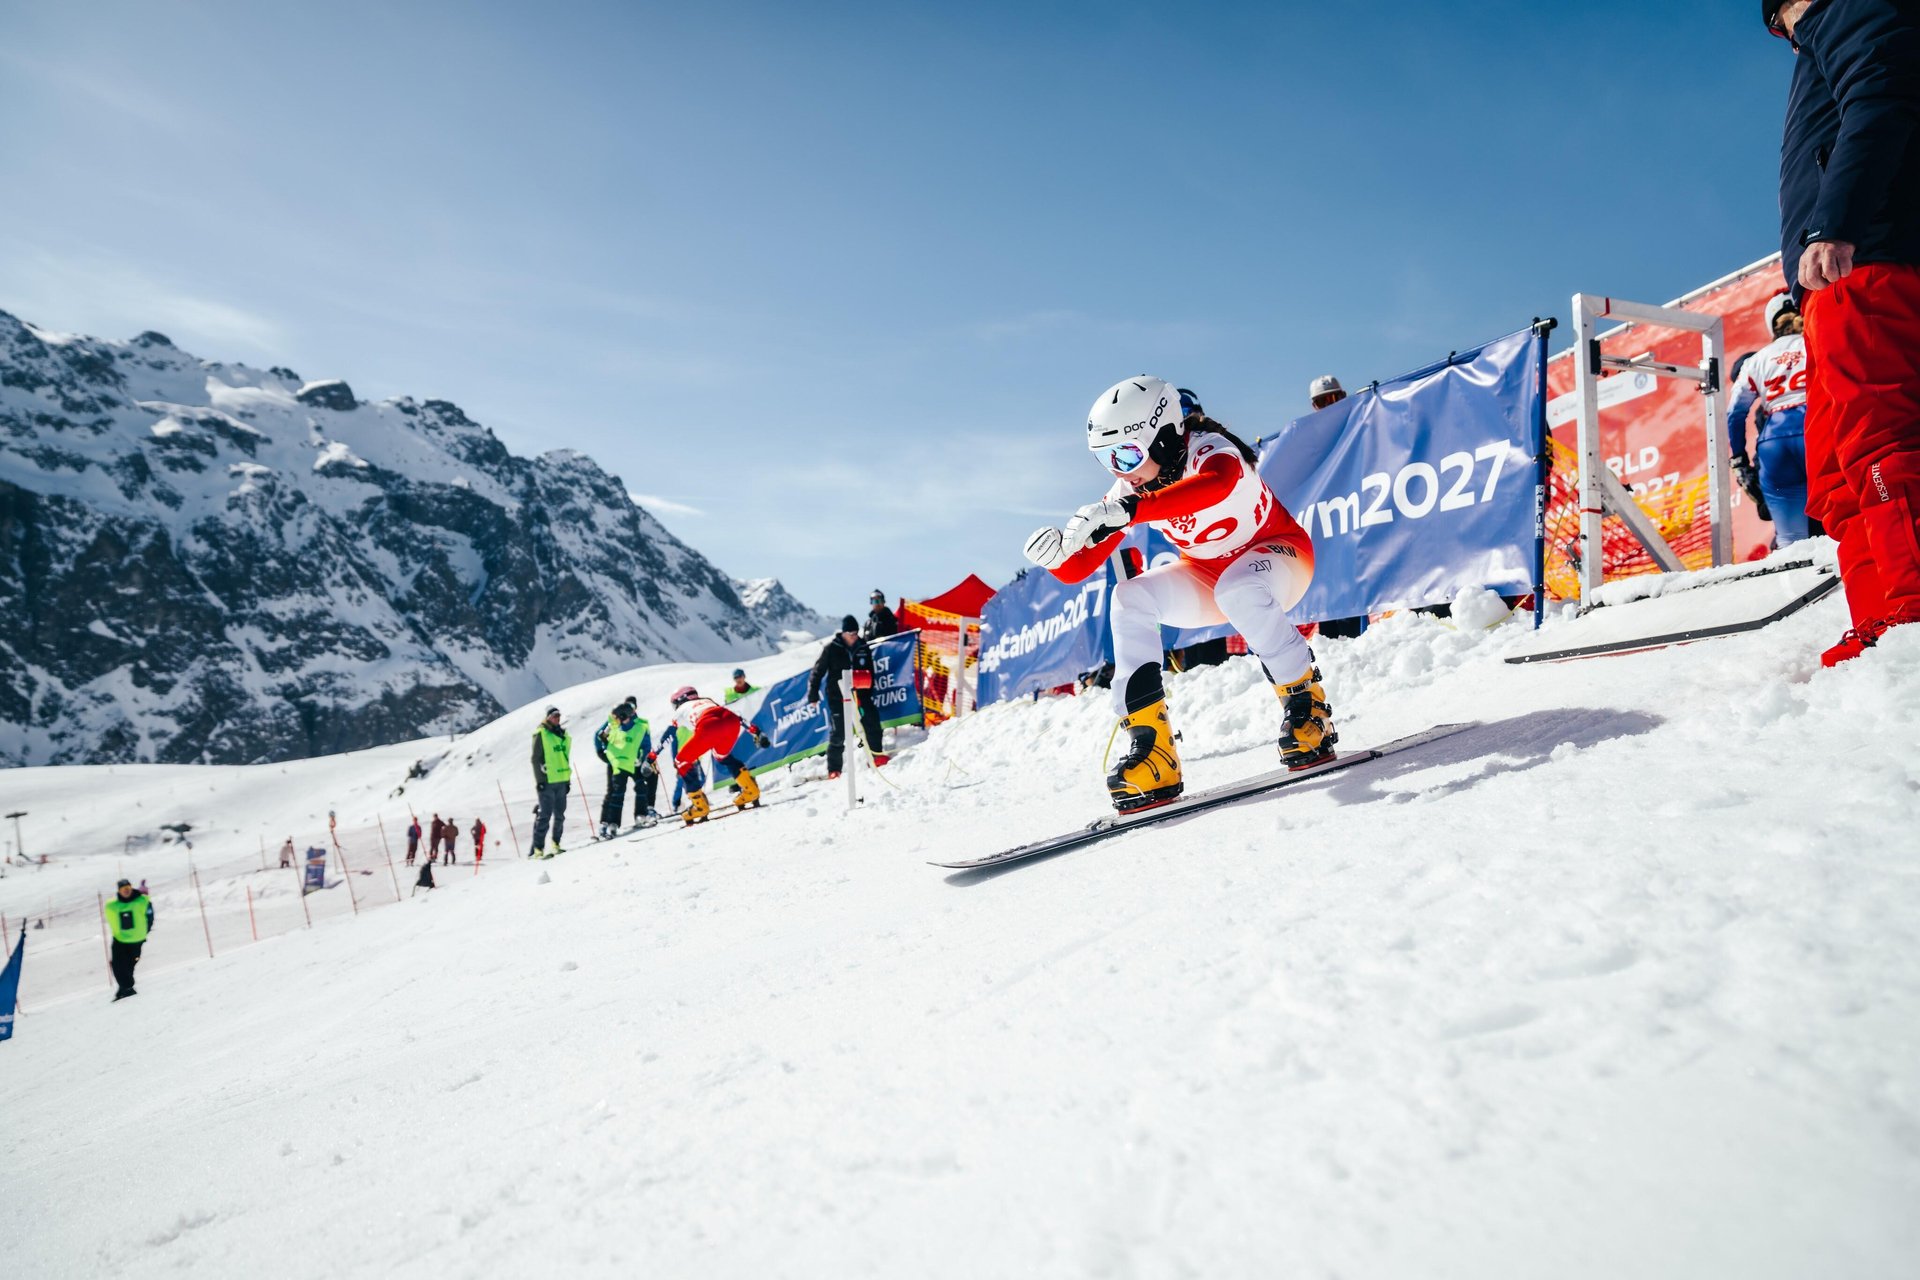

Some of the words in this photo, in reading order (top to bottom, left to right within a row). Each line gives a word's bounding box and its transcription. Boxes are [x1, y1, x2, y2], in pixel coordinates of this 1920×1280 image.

[1764, 370, 1806, 401] 36
[1150, 396, 1168, 429] poc
[1605, 446, 1660, 479] RLD
[1297, 438, 1511, 538] m2027
[1632, 472, 1680, 502] 027
[1871, 462, 1889, 502] DESCENTE
[1267, 544, 1297, 558] BKW
[870, 687, 907, 708] TUNG
[873, 673, 894, 691] AGE
